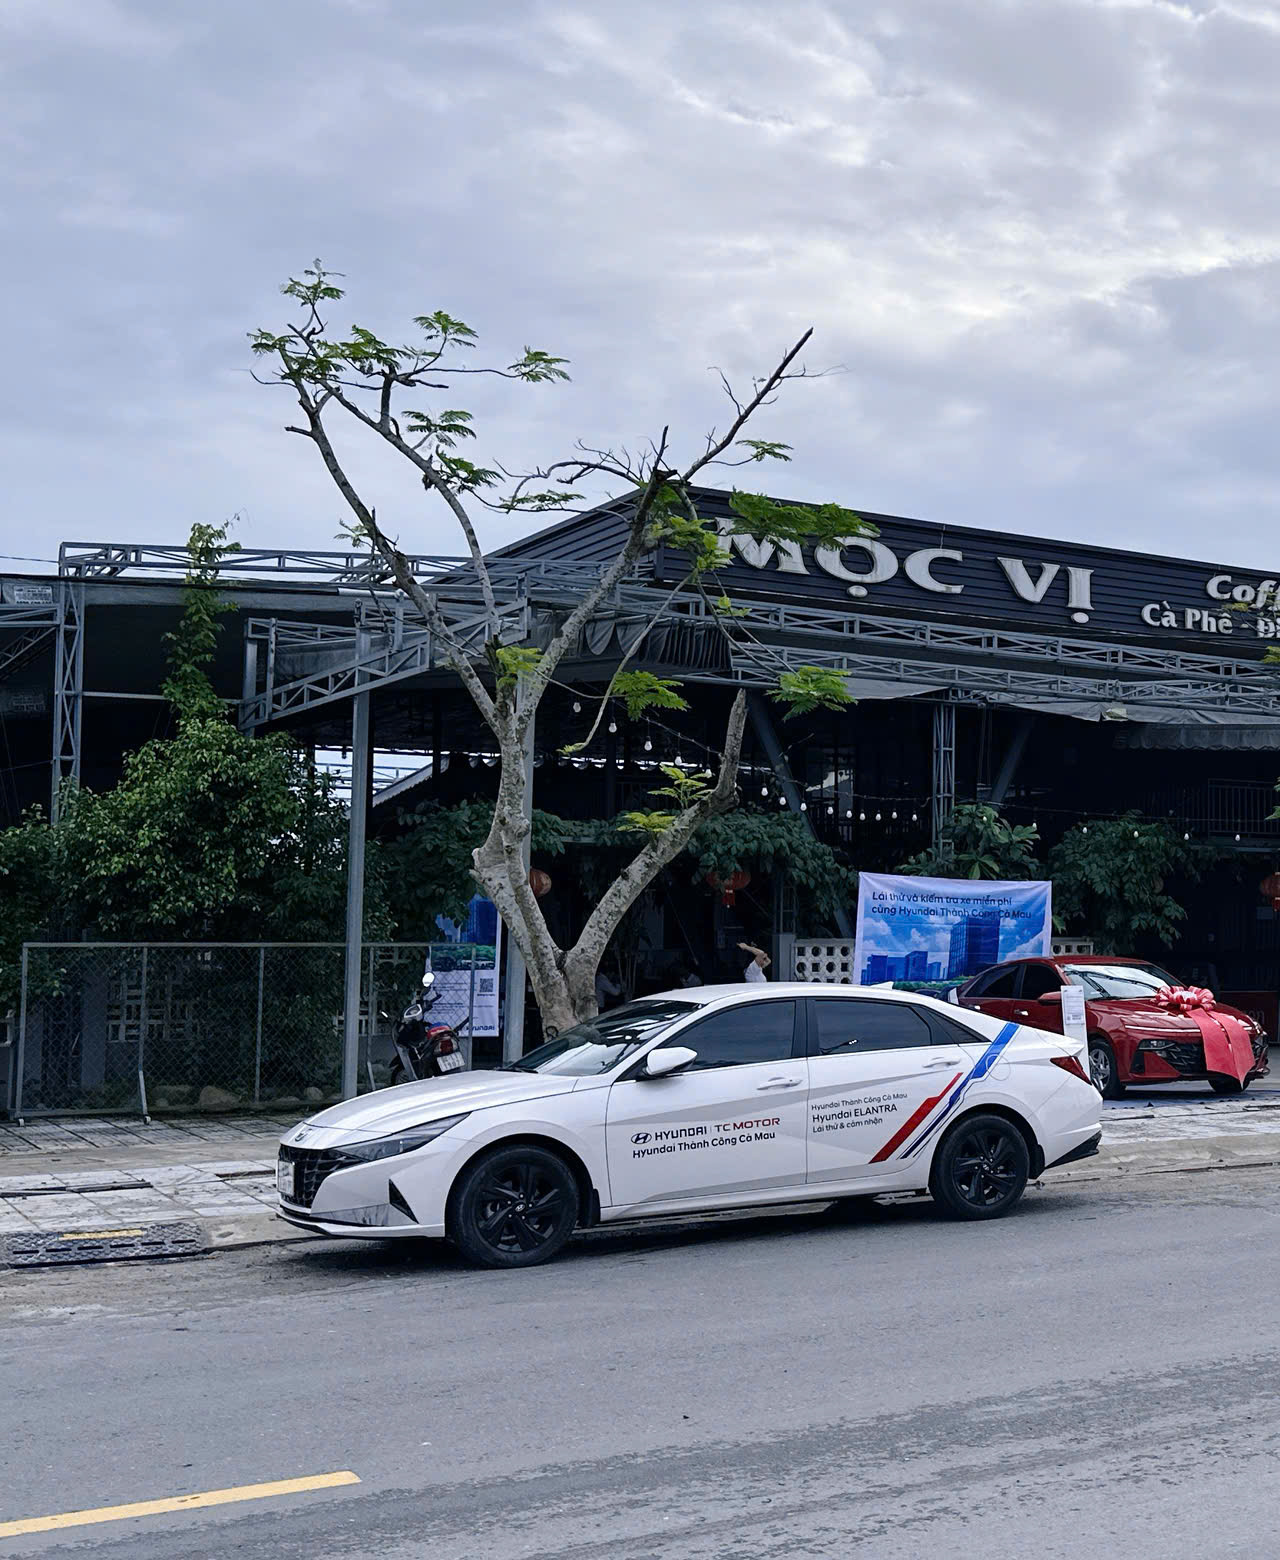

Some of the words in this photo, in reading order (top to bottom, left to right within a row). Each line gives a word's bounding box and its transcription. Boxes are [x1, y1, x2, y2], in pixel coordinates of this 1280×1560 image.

[996, 556, 1095, 624] VỊ
[1141, 600, 1178, 628] Cà
[1184, 607, 1234, 635] Phê
[872, 891, 888, 901] Lái
[906, 892, 919, 903] và
[945, 895, 959, 904] tra
[997, 896, 1012, 907] phí
[871, 904, 897, 916] cùng
[898, 905, 939, 917] Hyundai
[1011, 909, 1032, 919] Mau
[811, 1101, 840, 1111] Hyundai
[812, 1110, 852, 1124] Hyundai
[853, 1103, 898, 1117] ELANTRA
[654, 1125, 707, 1142] HYUNDAI
[714, 1123, 731, 1133] TC
[733, 1117, 781, 1131] MOTOR
[632, 1143, 676, 1159] Hyundai
[678, 1139, 710, 1152] Thành
[711, 1135, 737, 1147] Công
[739, 1132, 753, 1143] Cà
[754, 1131, 776, 1141] Mau
